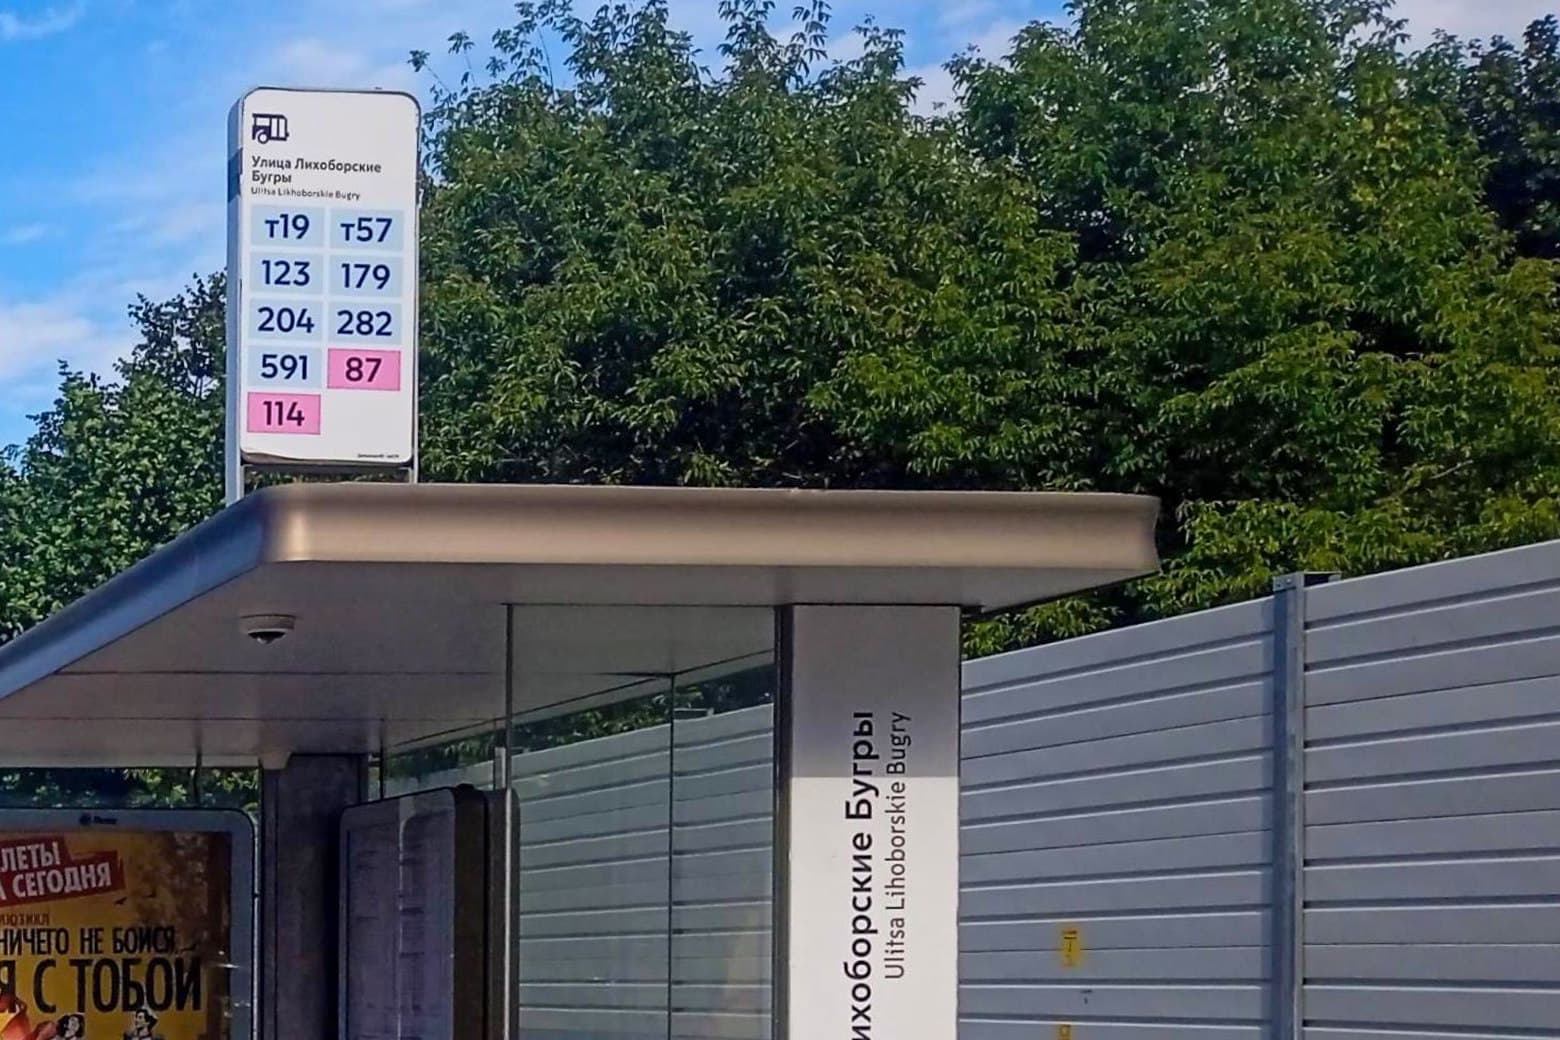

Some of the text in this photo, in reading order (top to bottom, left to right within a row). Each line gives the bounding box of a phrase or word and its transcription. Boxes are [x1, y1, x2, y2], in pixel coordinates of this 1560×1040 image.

[251, 155, 382, 174] Улица Лихоборские
[251, 170, 292, 185] Бугры
[250, 186, 276, 196] Ulitsa
[335, 190, 361, 201] Bugry
[262, 259, 311, 286] 123
[341, 263, 391, 290] 179
[257, 307, 315, 334] 204
[336, 310, 393, 337] 282
[260, 354, 309, 380] 591
[344, 356, 382, 382] 87
[262, 401, 305, 426] 114
[845, 711, 880, 821] Бугры
[884, 711, 911, 980] Ulitsa Lihoborskie Bugry
[11, 861, 113, 899] СЕГОДНЯ
[79, 926, 105, 955] НЕ
[32, 958, 58, 1014] С
[69, 956, 202, 1014] ТОБОЙ
